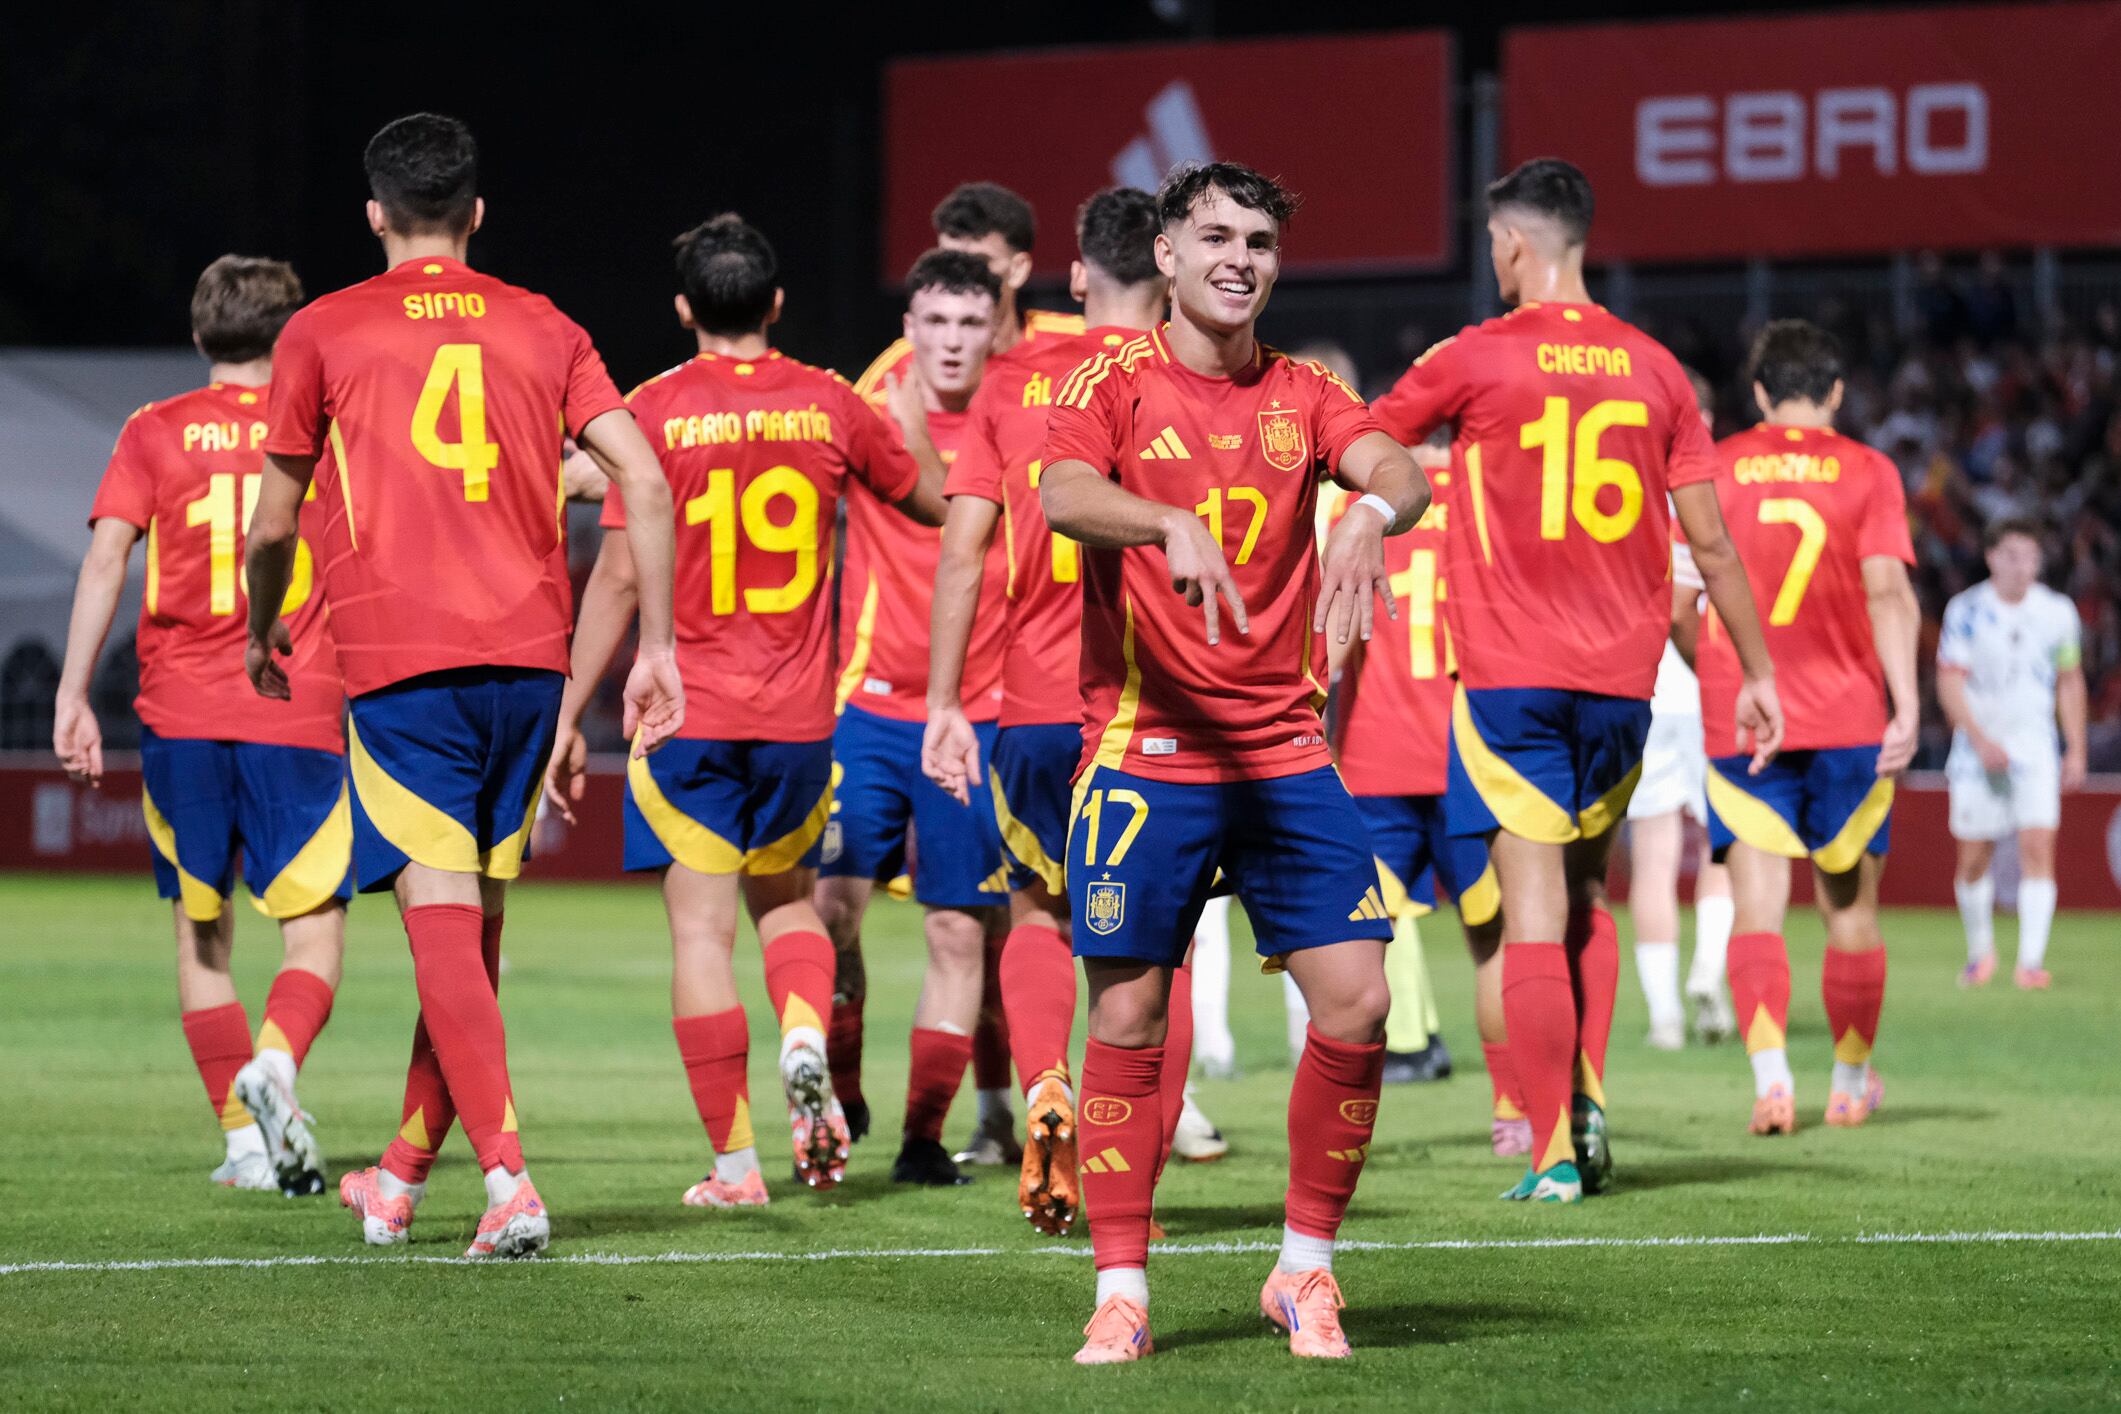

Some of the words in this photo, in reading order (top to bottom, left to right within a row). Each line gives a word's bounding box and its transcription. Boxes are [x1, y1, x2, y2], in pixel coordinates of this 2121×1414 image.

[403, 292, 486, 320] SIMO
[1537, 343, 1631, 377] CHEMA
[183, 422, 240, 451] PAU
[410, 343, 499, 503] 4
[663, 412, 741, 450] MARIO
[1519, 396, 1649, 544] 16
[1734, 452, 1841, 485] GONZALO
[685, 465, 819, 616] 19
[1195, 486, 1268, 565] 17
[1757, 497, 1827, 627] 7
[1388, 549, 1448, 680] 1
[1081, 789, 1149, 866] 17
